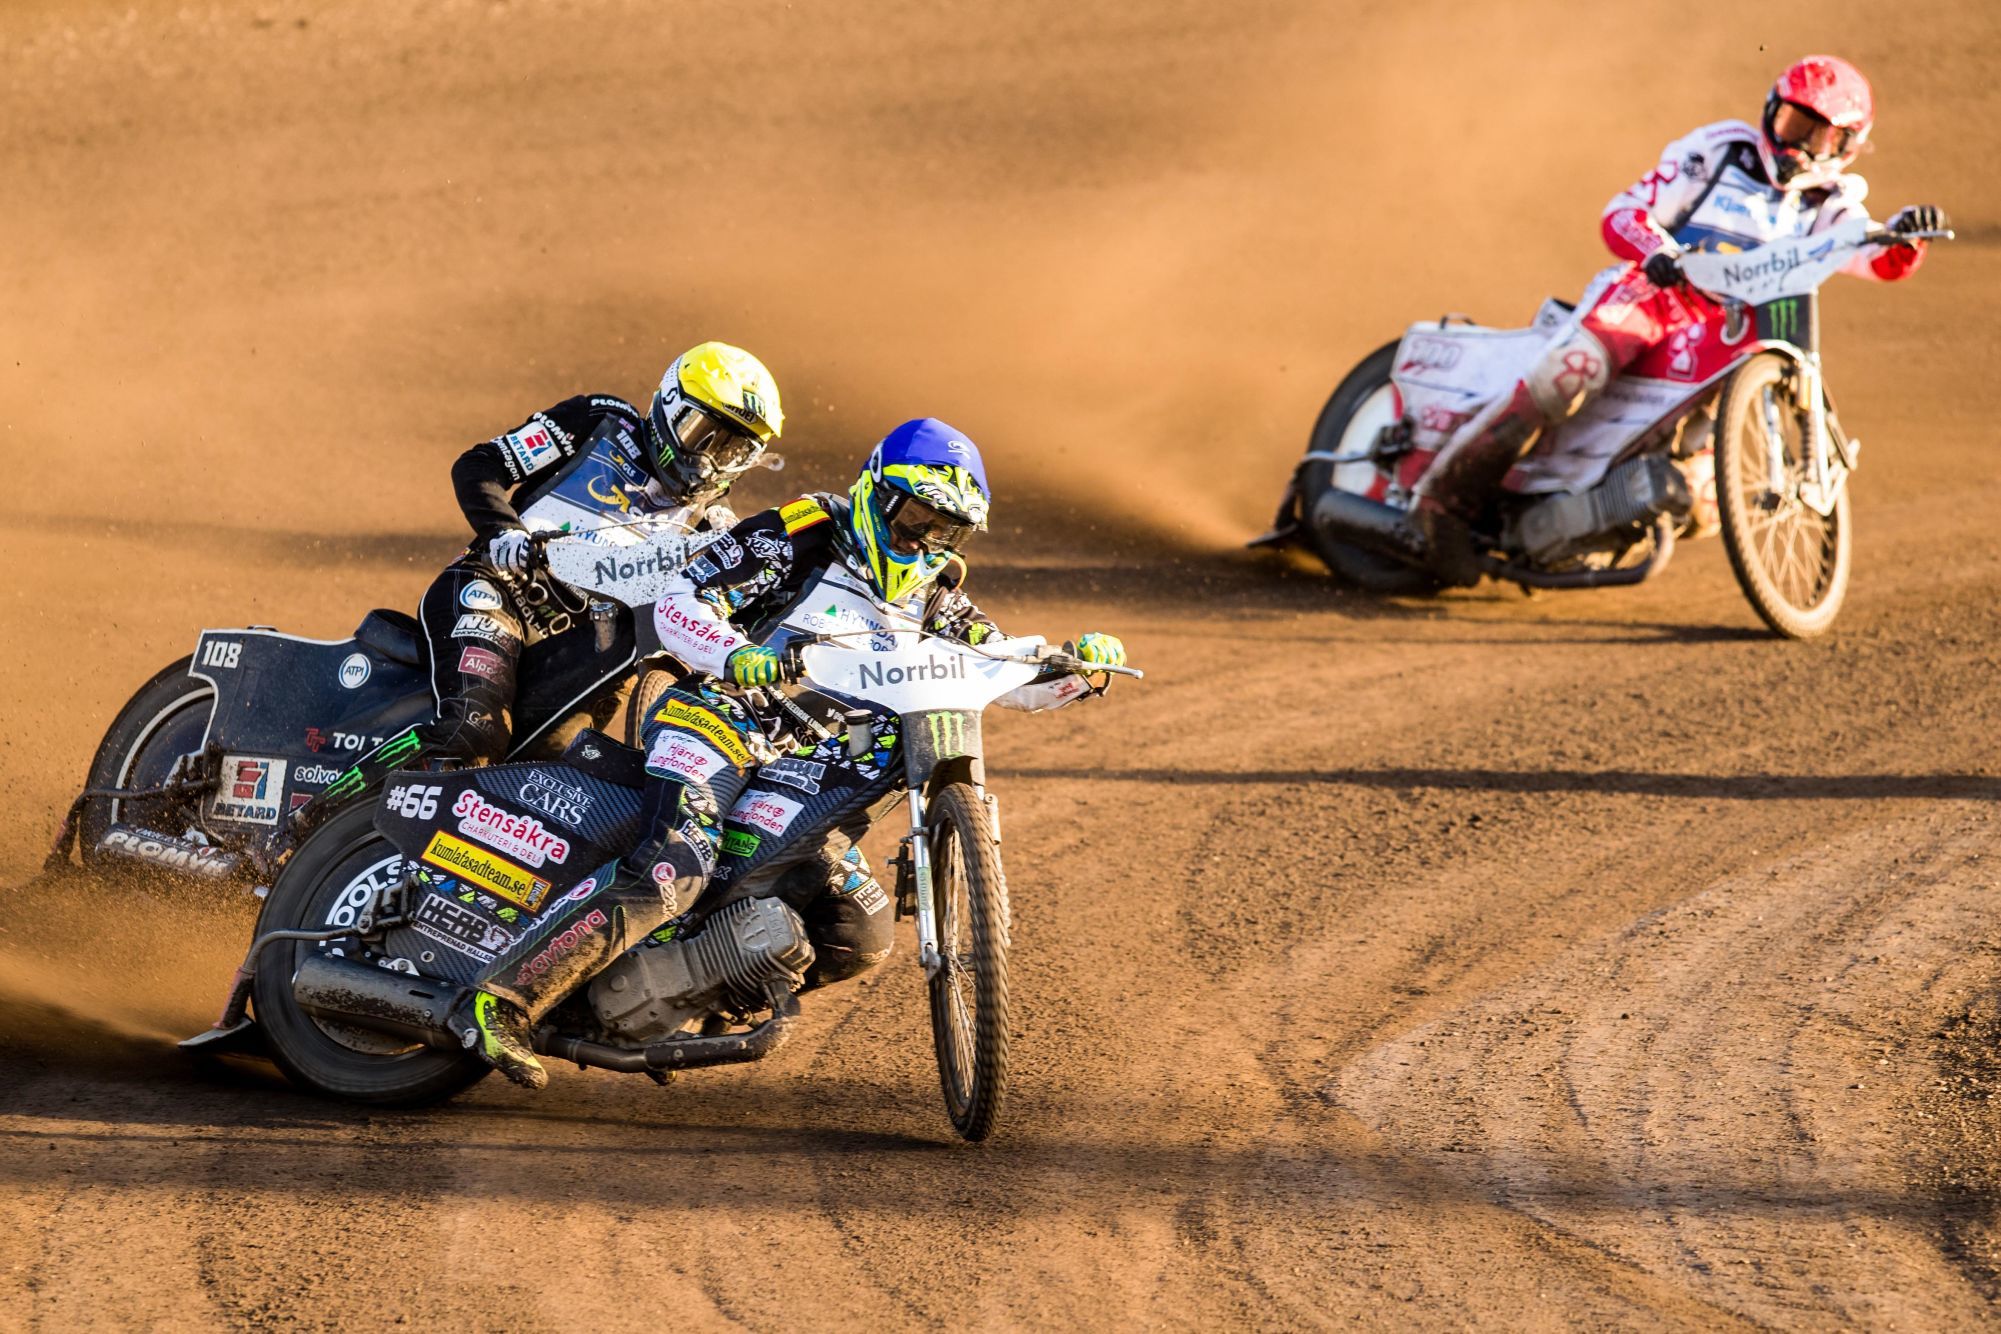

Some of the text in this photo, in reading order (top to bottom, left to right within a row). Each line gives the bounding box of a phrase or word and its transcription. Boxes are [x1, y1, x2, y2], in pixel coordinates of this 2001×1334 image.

[1723, 248, 1799, 287] Norrbil
[510, 435, 535, 471] BETARD
[533, 412, 575, 457] PLOMYK
[616, 429, 642, 460] 108
[622, 463, 637, 478] GLS
[594, 541, 690, 585] Norrbil
[468, 589, 497, 602] ATPI
[201, 640, 243, 668] 108
[344, 664, 366, 678] ATPI
[859, 653, 965, 690] Norrbil
[386, 784, 443, 820] #66
[518, 782, 587, 826] CARS
[528, 769, 592, 807] EXCLUSIVE
[214, 801, 277, 820] BETARD
[456, 792, 568, 860] Stensåkra
[461, 821, 511, 848] CHARKUTERI
[518, 848, 541, 864] DELI
[429, 837, 527, 897] kumlafasadteam.se
[420, 894, 487, 941] HERB
